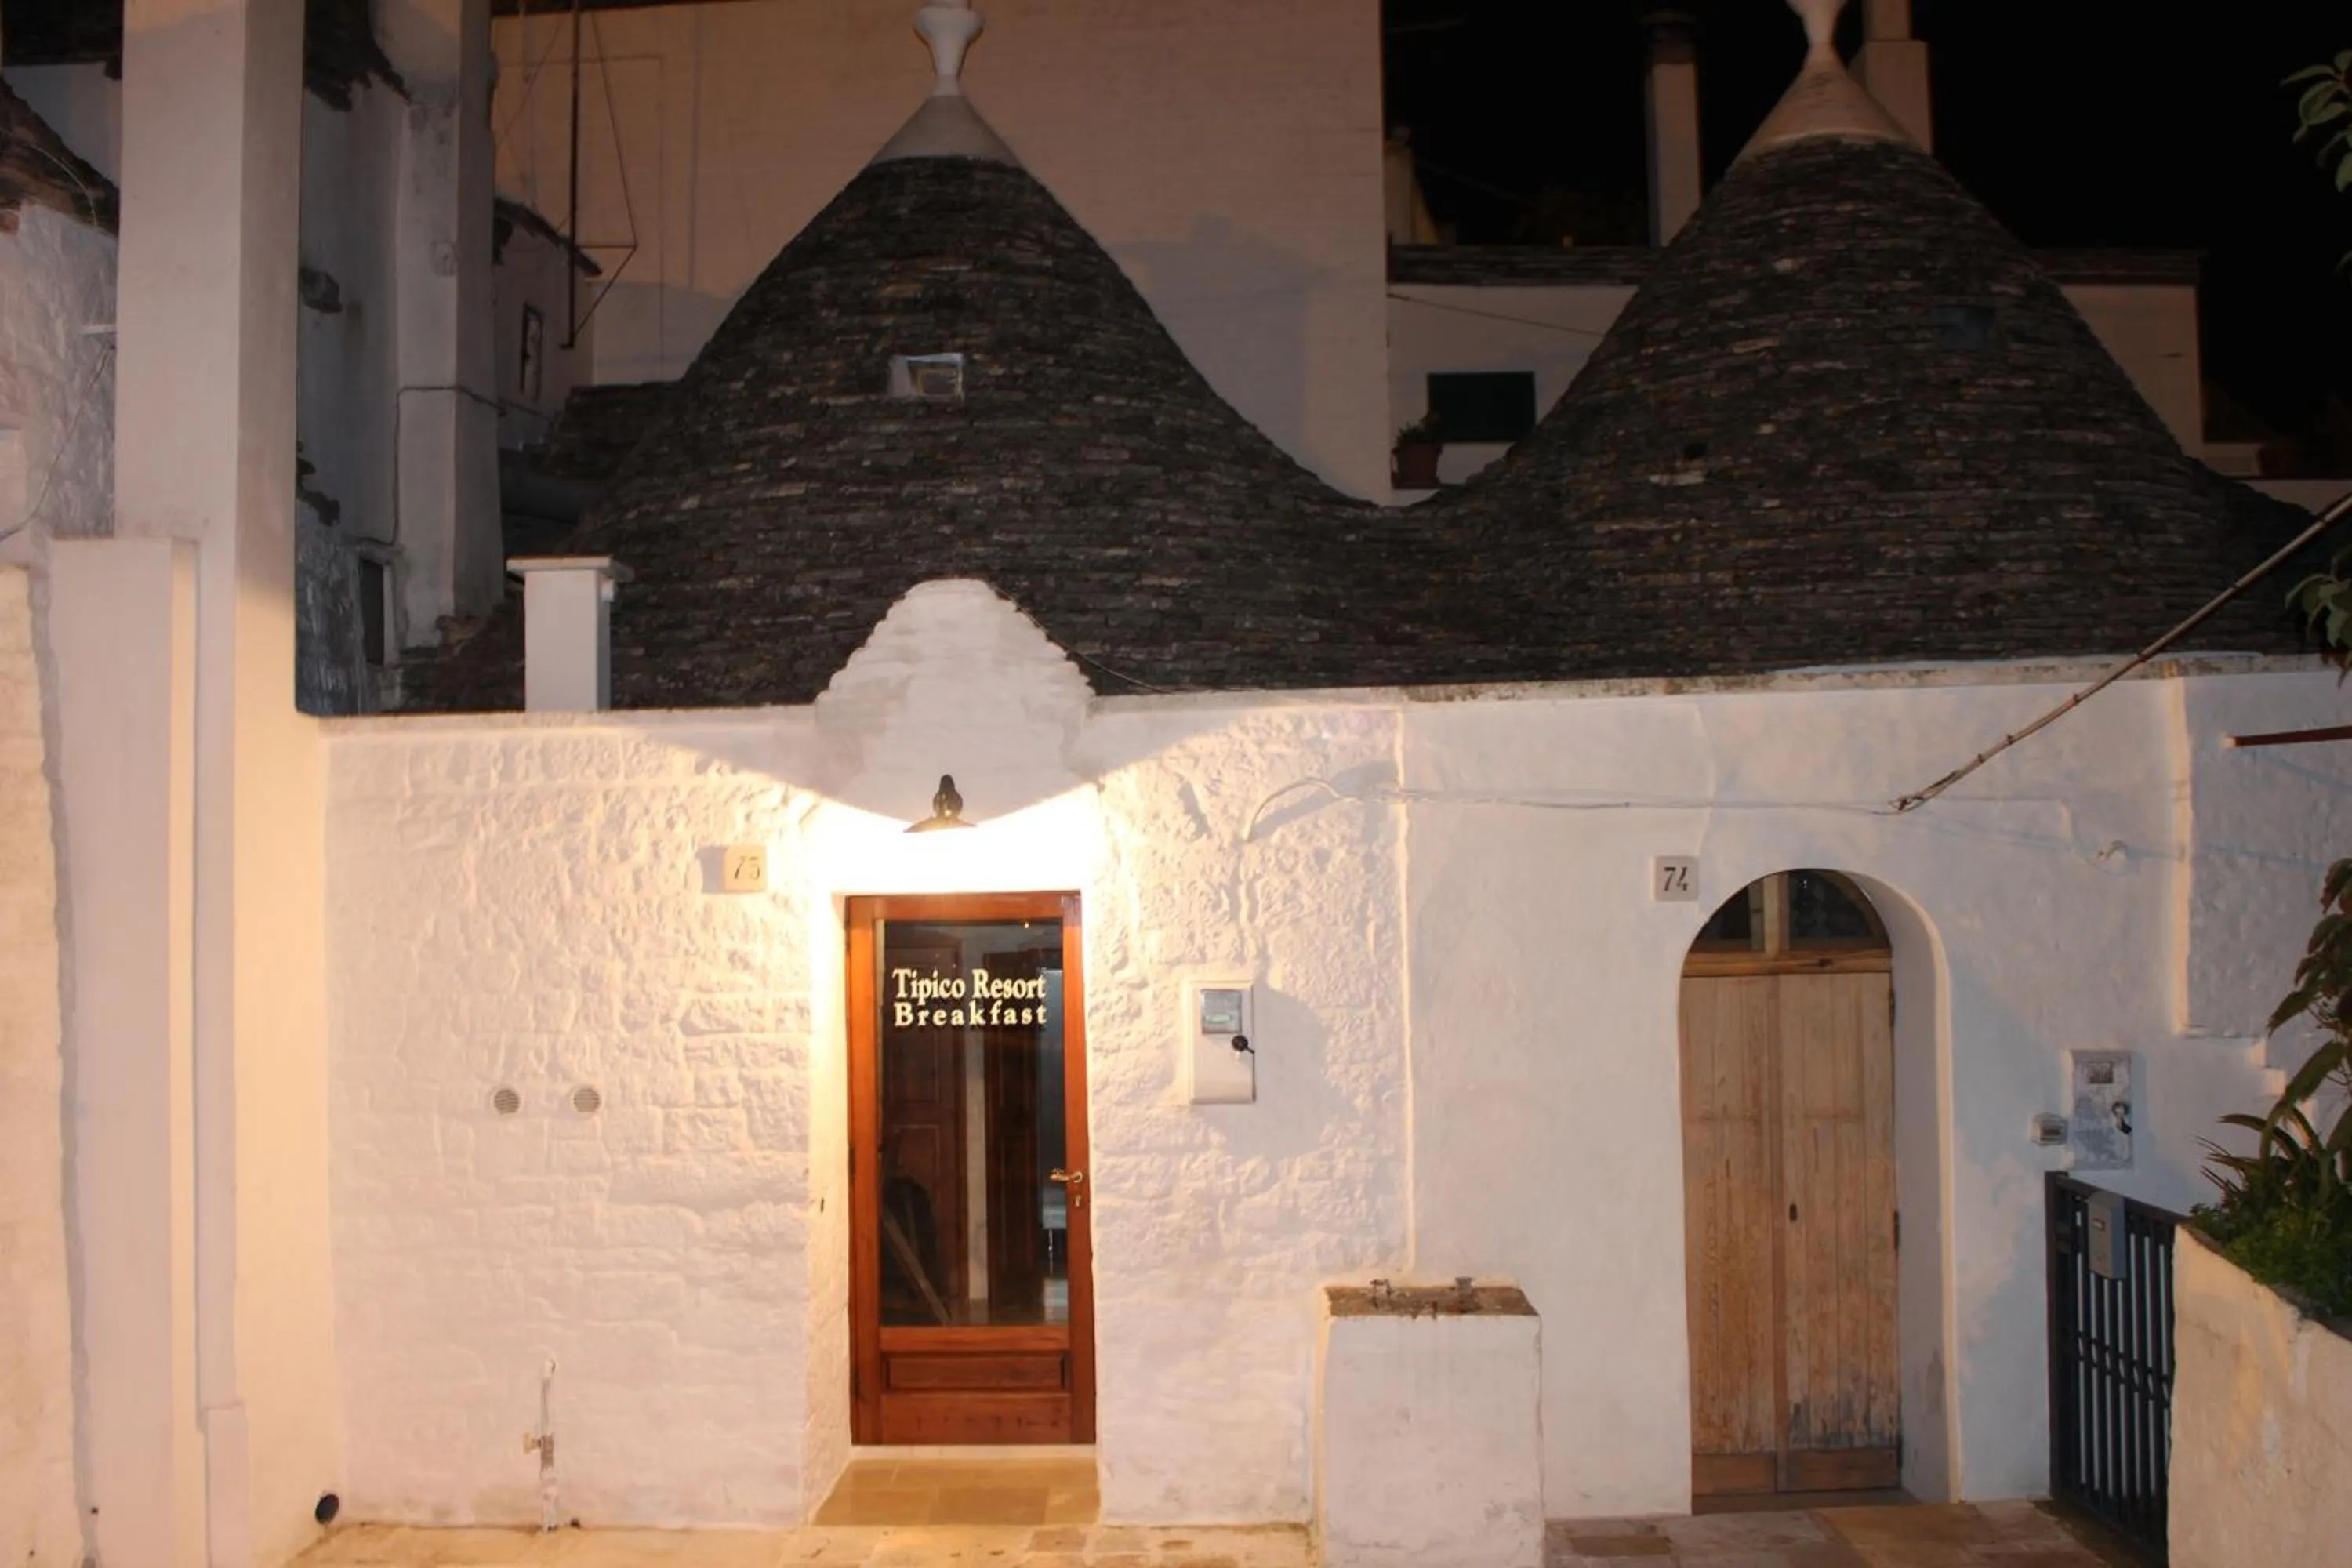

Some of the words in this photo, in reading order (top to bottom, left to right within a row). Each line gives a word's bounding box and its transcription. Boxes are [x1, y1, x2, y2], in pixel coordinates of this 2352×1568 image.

[732, 855, 761, 880] 75
[1664, 866, 1689, 891] 74
[892, 967, 966, 1005] Tipico
[972, 968, 1047, 999] Resort
[893, 1000, 1047, 1027] Breakfast
